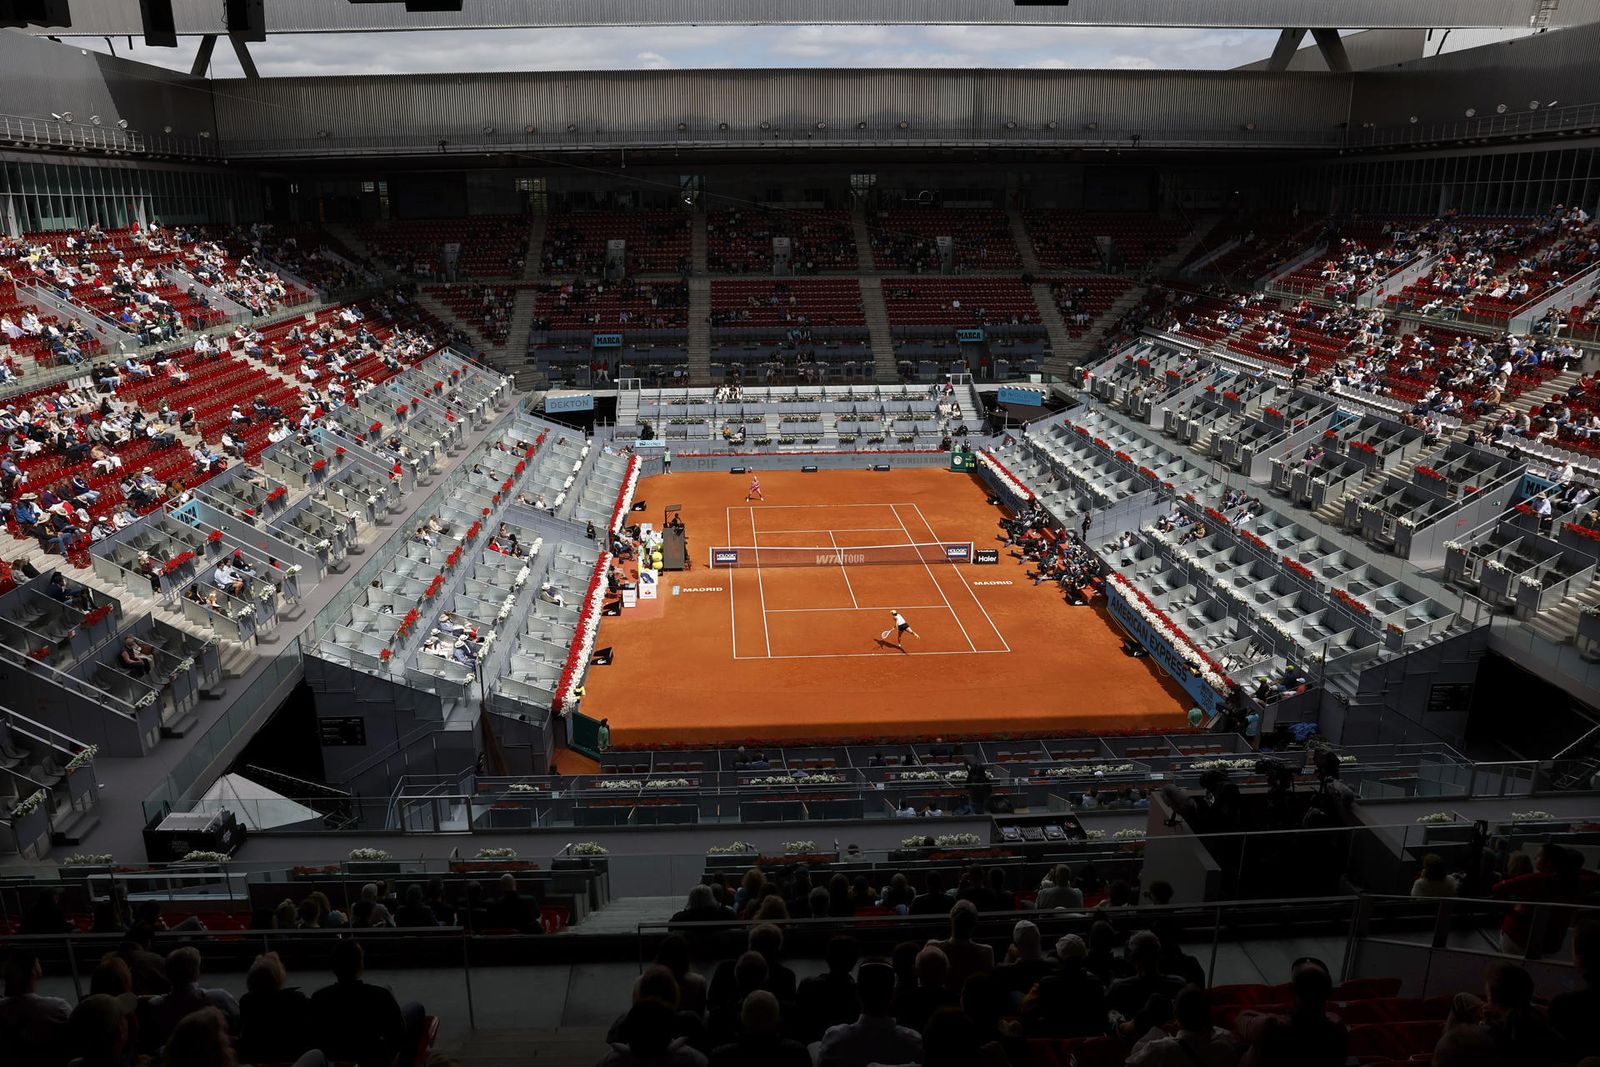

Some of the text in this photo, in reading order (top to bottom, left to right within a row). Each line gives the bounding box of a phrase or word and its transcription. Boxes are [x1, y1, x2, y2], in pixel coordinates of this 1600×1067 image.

[551, 399, 589, 409] DEKTON
[697, 459, 718, 469] PIF
[816, 554, 865, 564] WTA TOUR
[1111, 596, 1188, 682] AMERICAN EXPRESS
